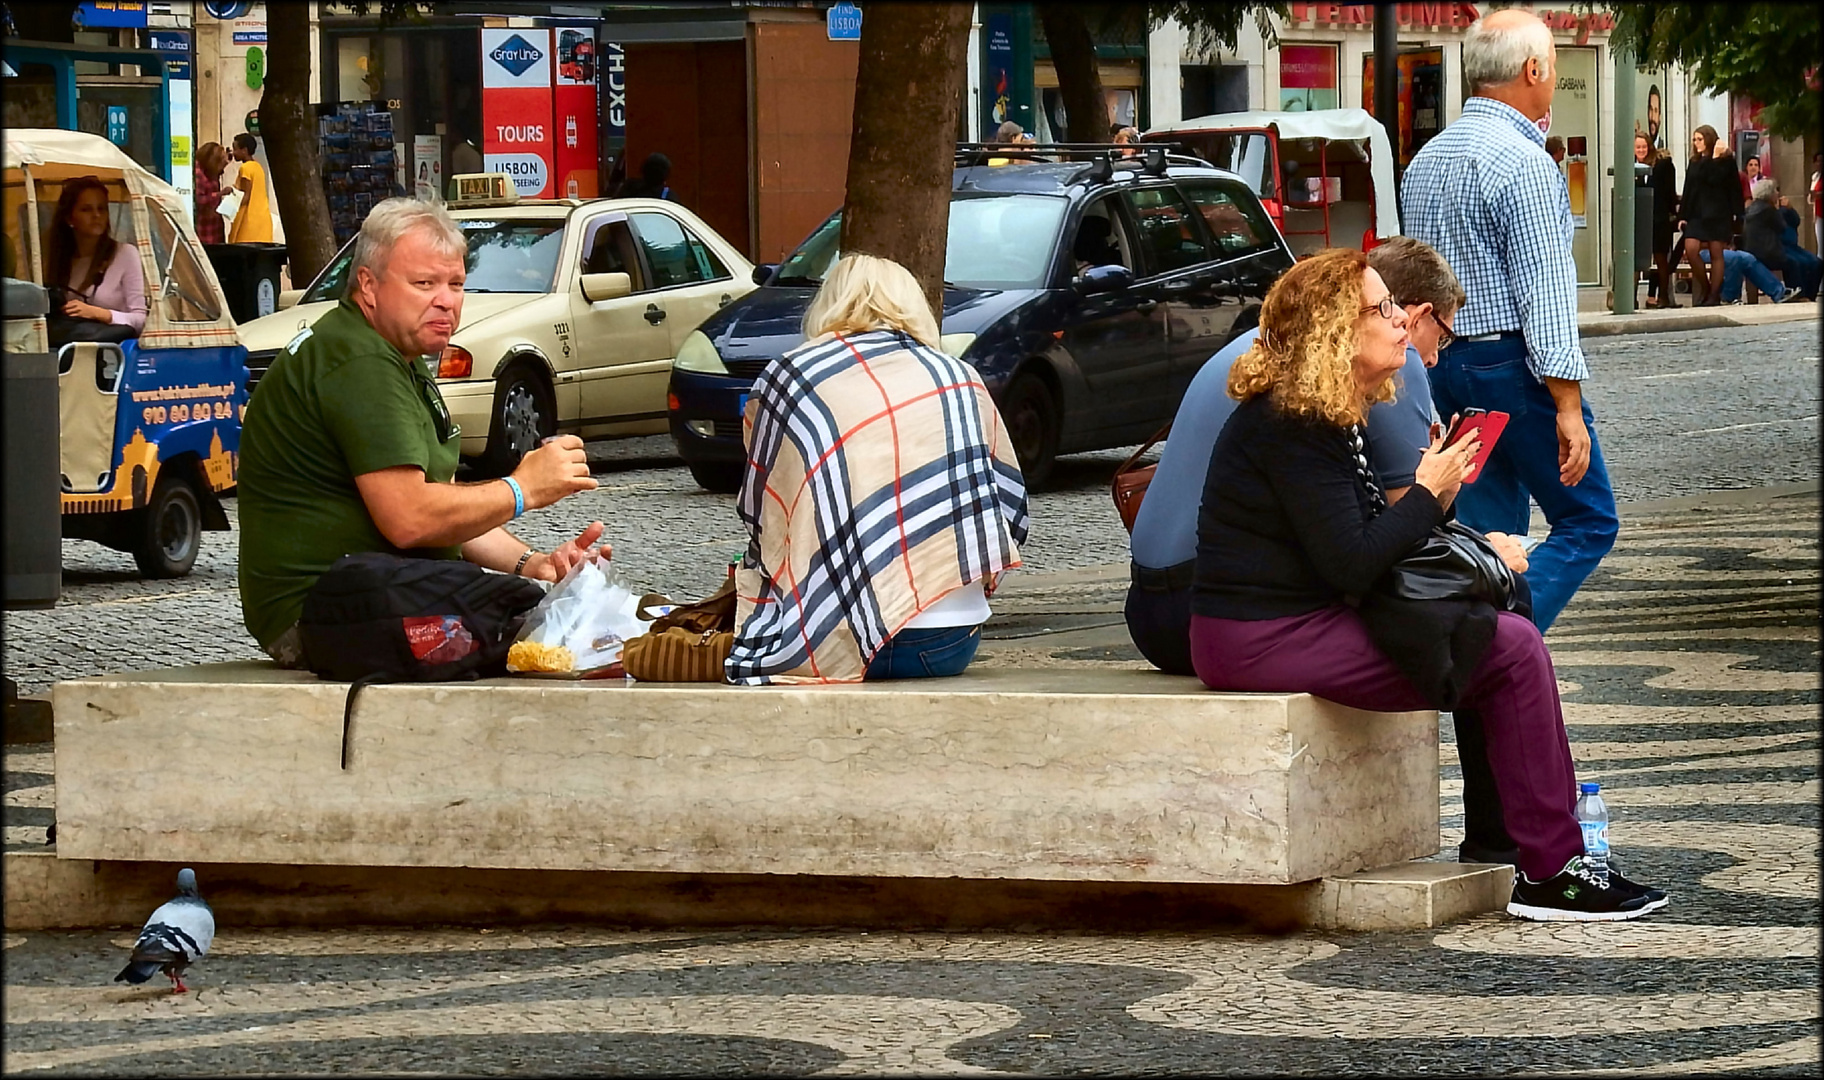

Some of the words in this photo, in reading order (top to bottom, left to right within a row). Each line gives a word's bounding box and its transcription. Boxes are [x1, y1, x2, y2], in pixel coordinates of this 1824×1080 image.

[838, 6, 853, 14] FIND
[830, 18, 860, 30] LISBOA
[496, 125, 544, 143] TOURS
[496, 162, 538, 175] LISBON
[462, 179, 488, 194] TAXI
